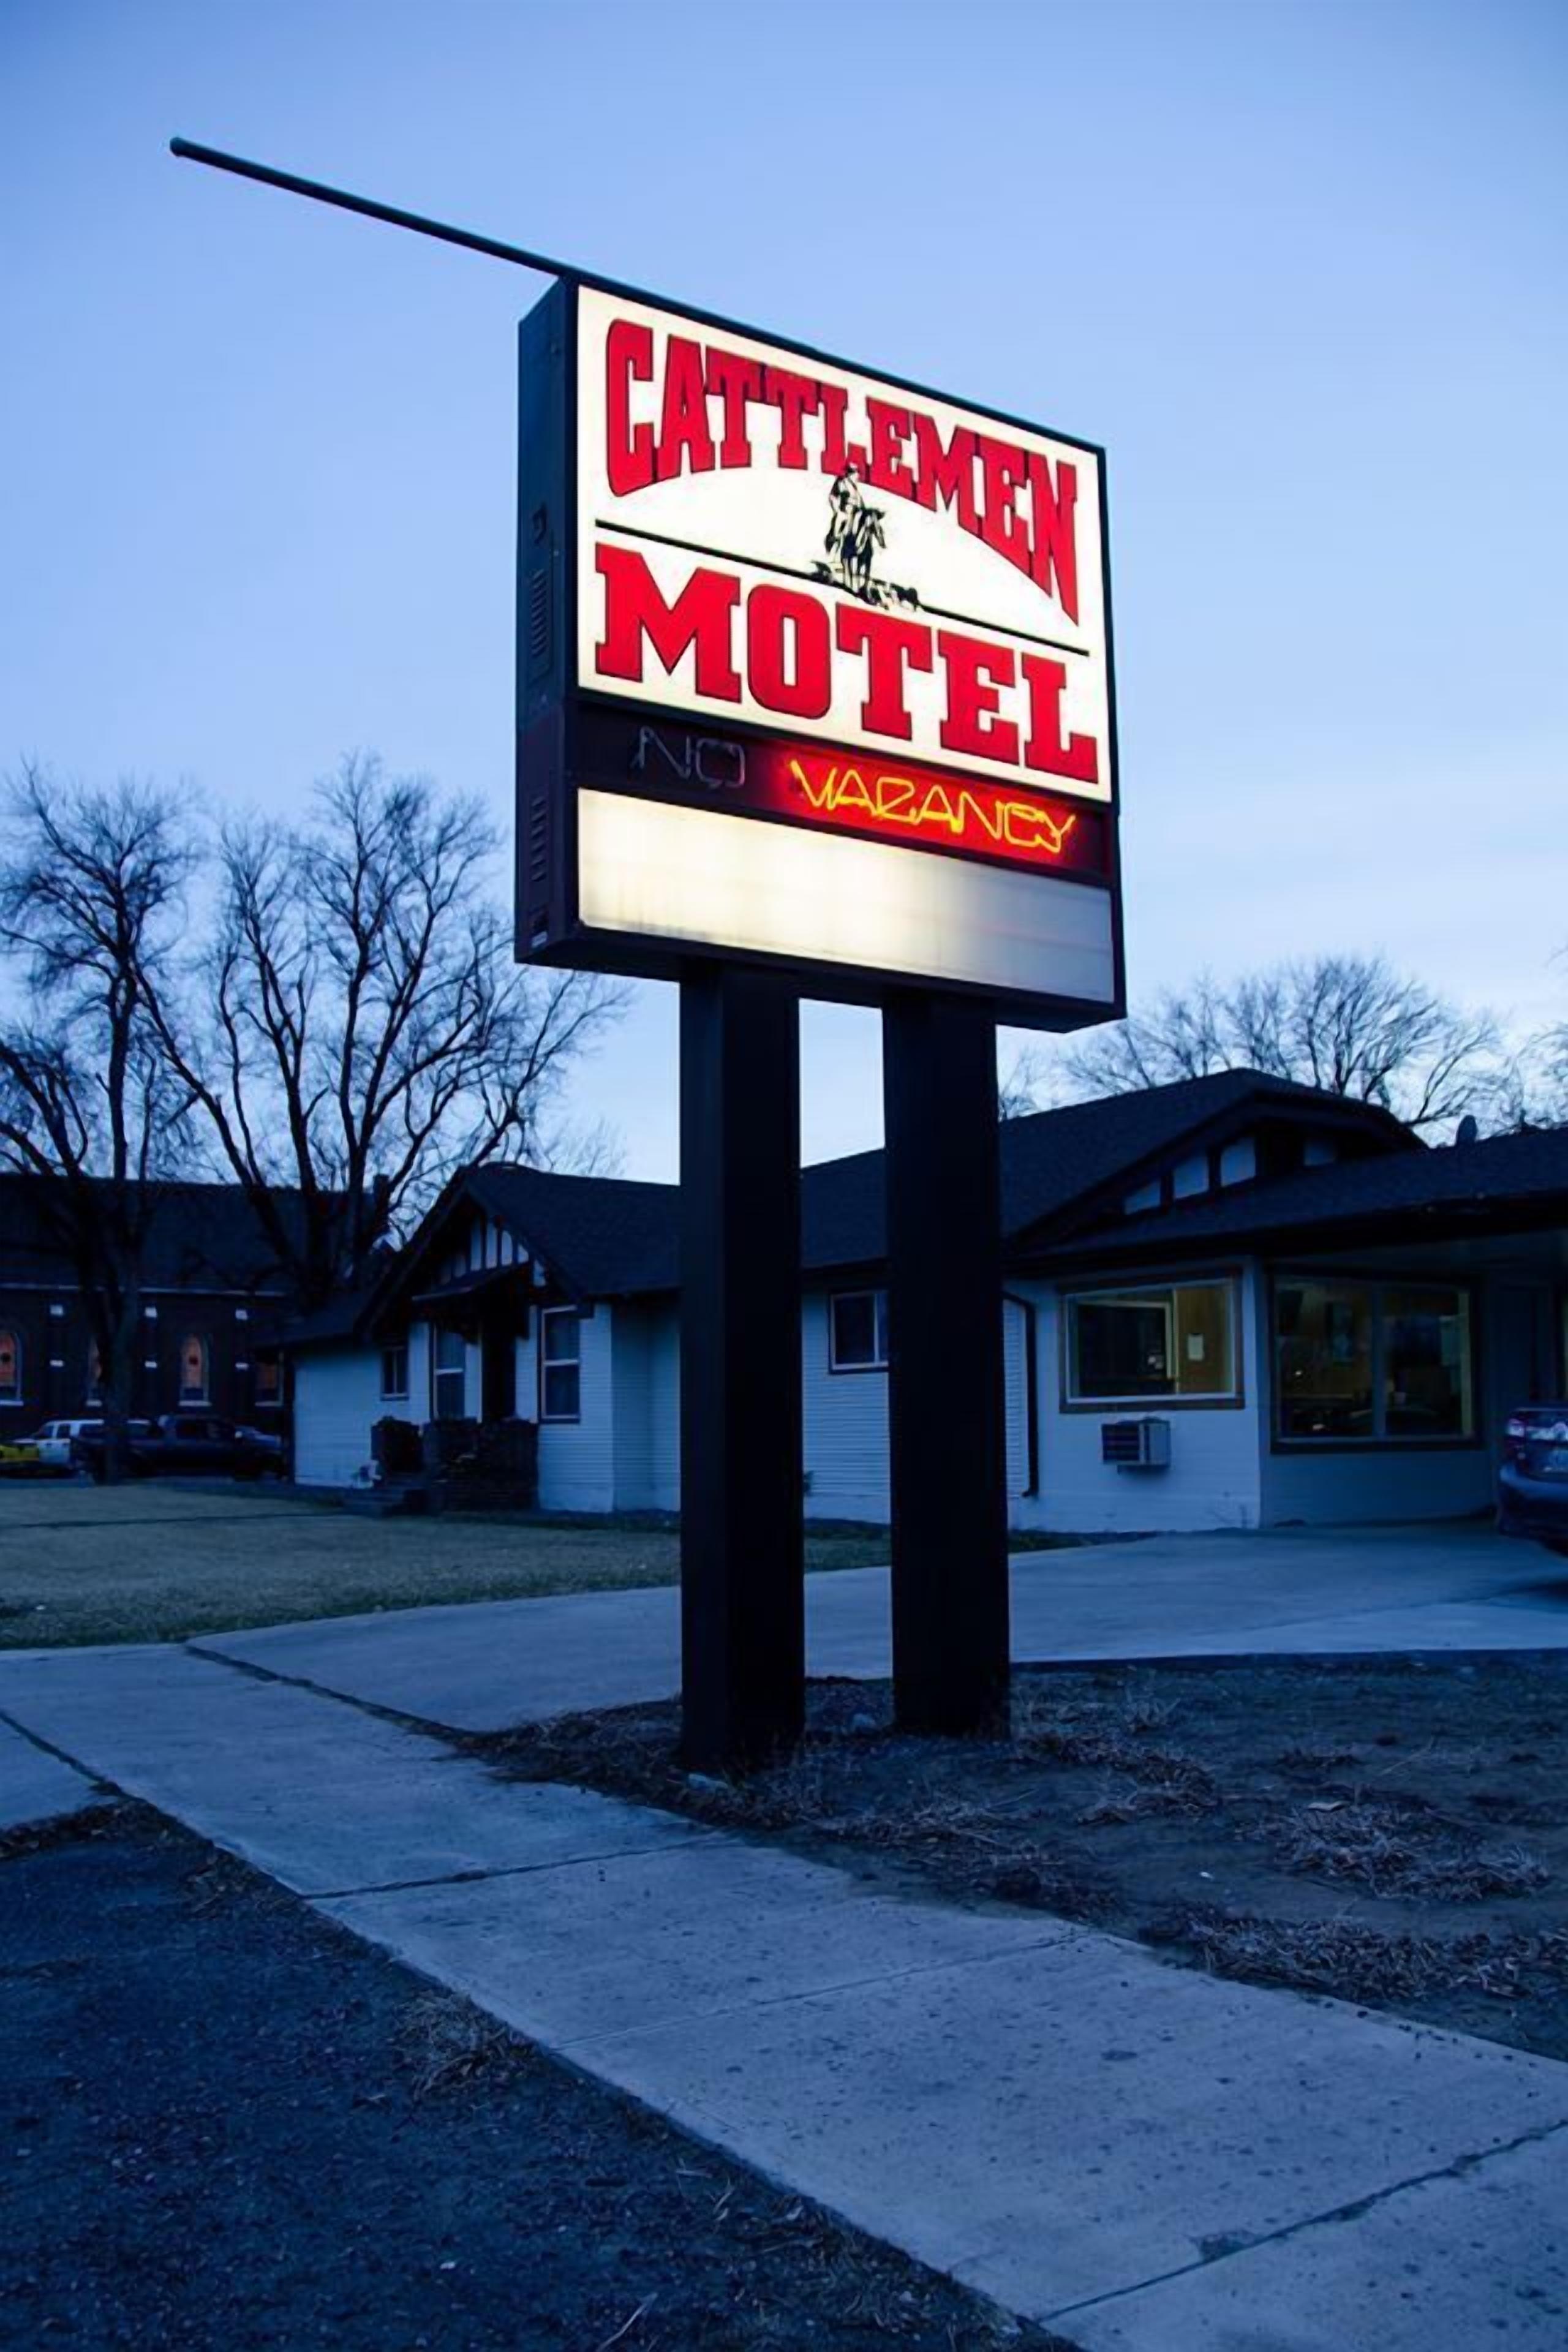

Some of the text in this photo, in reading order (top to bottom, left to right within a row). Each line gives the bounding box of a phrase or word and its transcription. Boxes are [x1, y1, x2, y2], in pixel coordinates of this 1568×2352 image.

[606, 319, 1079, 626] CATTLEMEN
[595, 543, 1098, 783] MOTEL
[632, 725, 1076, 853] NO VACANCY
